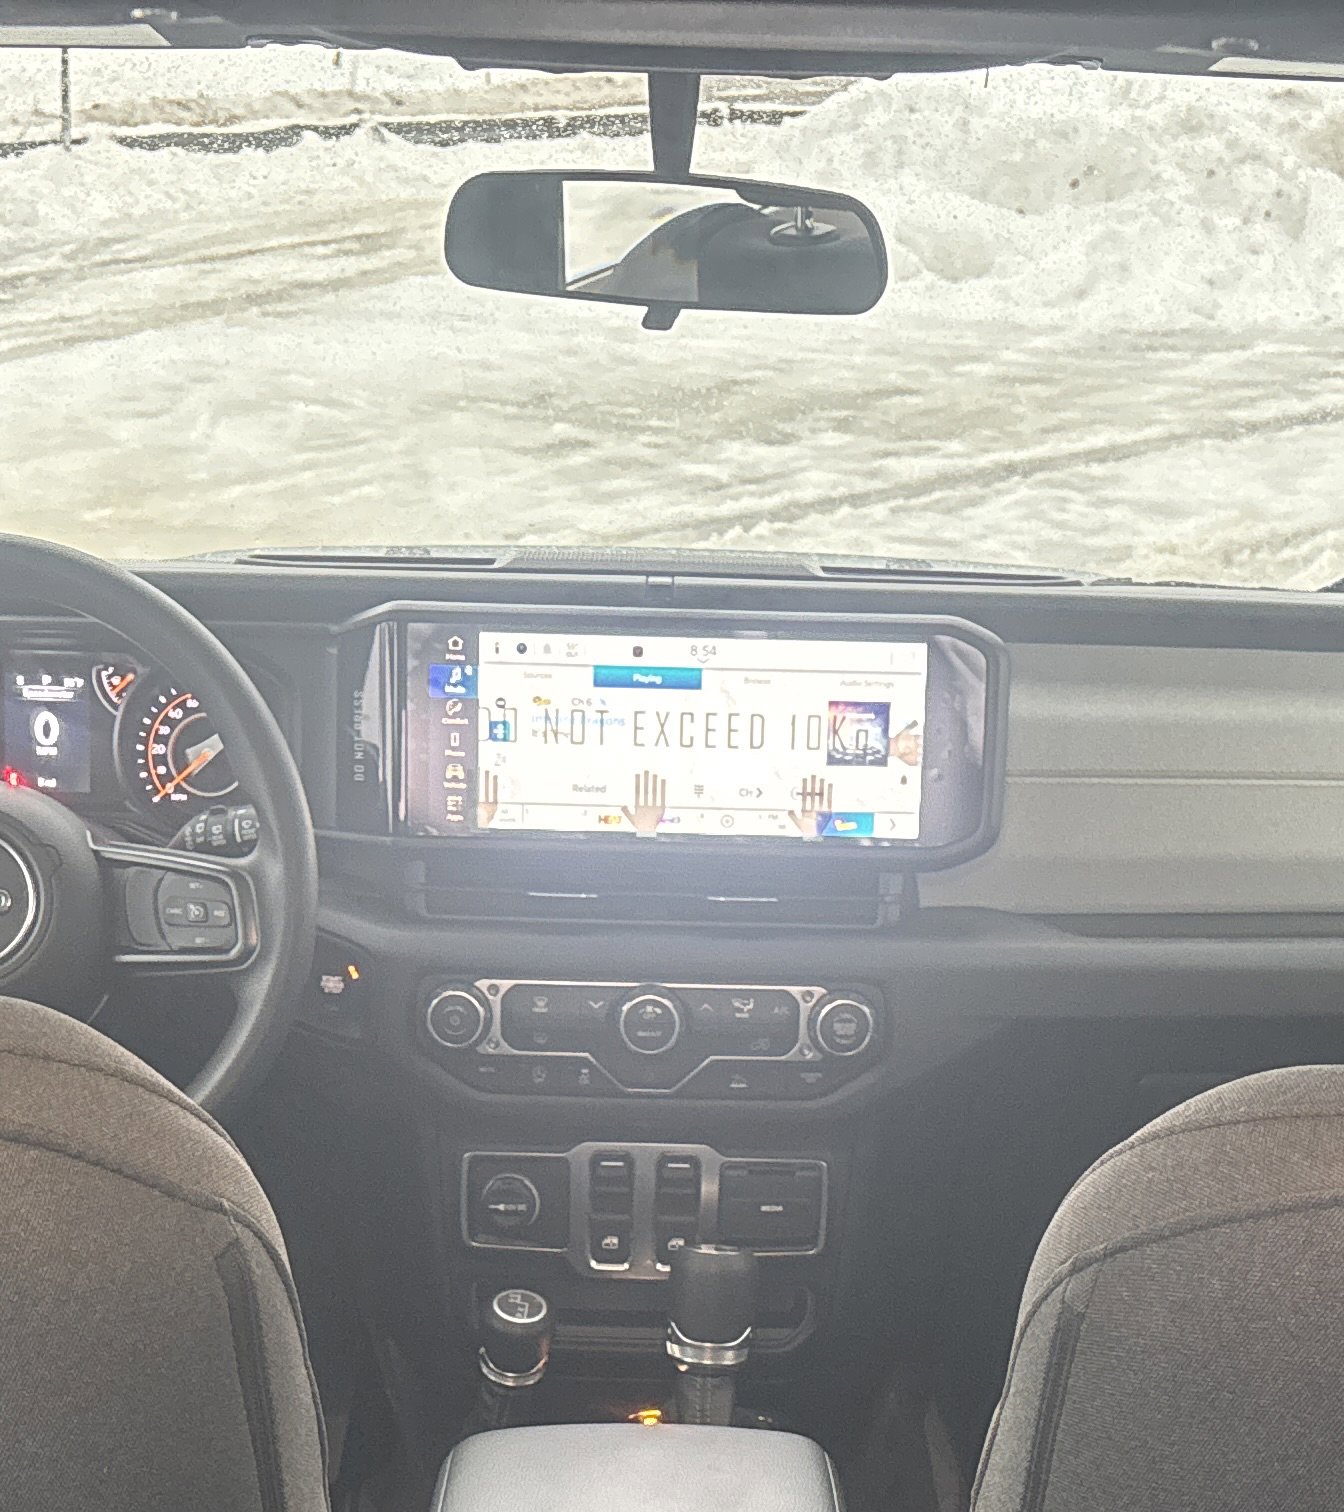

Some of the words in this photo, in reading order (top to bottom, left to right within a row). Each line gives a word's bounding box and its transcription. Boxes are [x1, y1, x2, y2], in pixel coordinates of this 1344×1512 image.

[690, 645, 717, 657] 854
[33, 710, 60, 746] 0
[543, 708, 610, 746] NOT
[633, 710, 765, 750] EXCEED
[151, 743, 167, 755] 20
[353, 735, 365, 760] NOT
[353, 764, 365, 782] DO
[572, 784, 607, 794] Related
